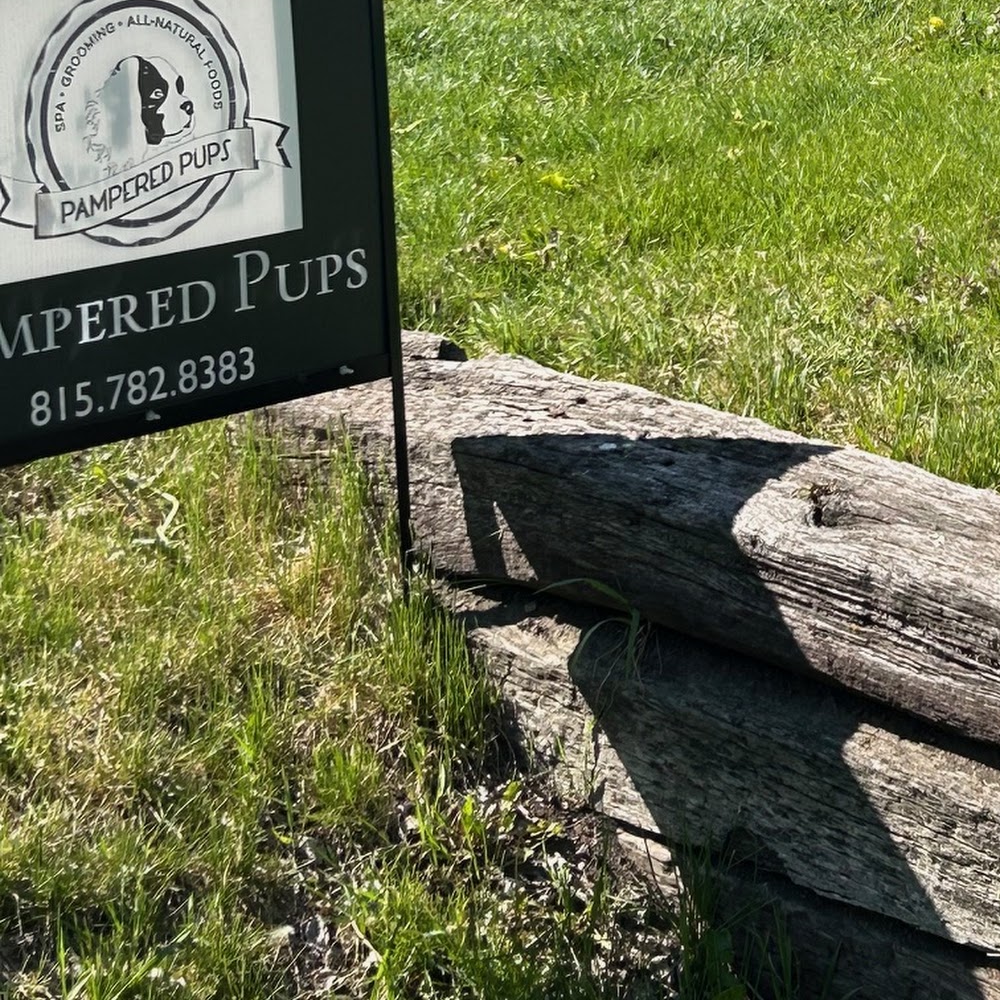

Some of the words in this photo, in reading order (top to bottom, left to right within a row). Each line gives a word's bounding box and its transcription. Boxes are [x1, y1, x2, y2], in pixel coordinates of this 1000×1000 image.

[60, 22, 117, 88] GROOMING
[127, 15, 205, 61] ALL-NATURAL
[55, 102, 66, 132] SPA
[203, 60, 223, 110] FOODS
[61, 160, 174, 224] PAMPERED
[178, 139, 232, 175] PUPS
[233, 248, 369, 313] PUPS
[30, 346, 256, 427] 815.782.8383
